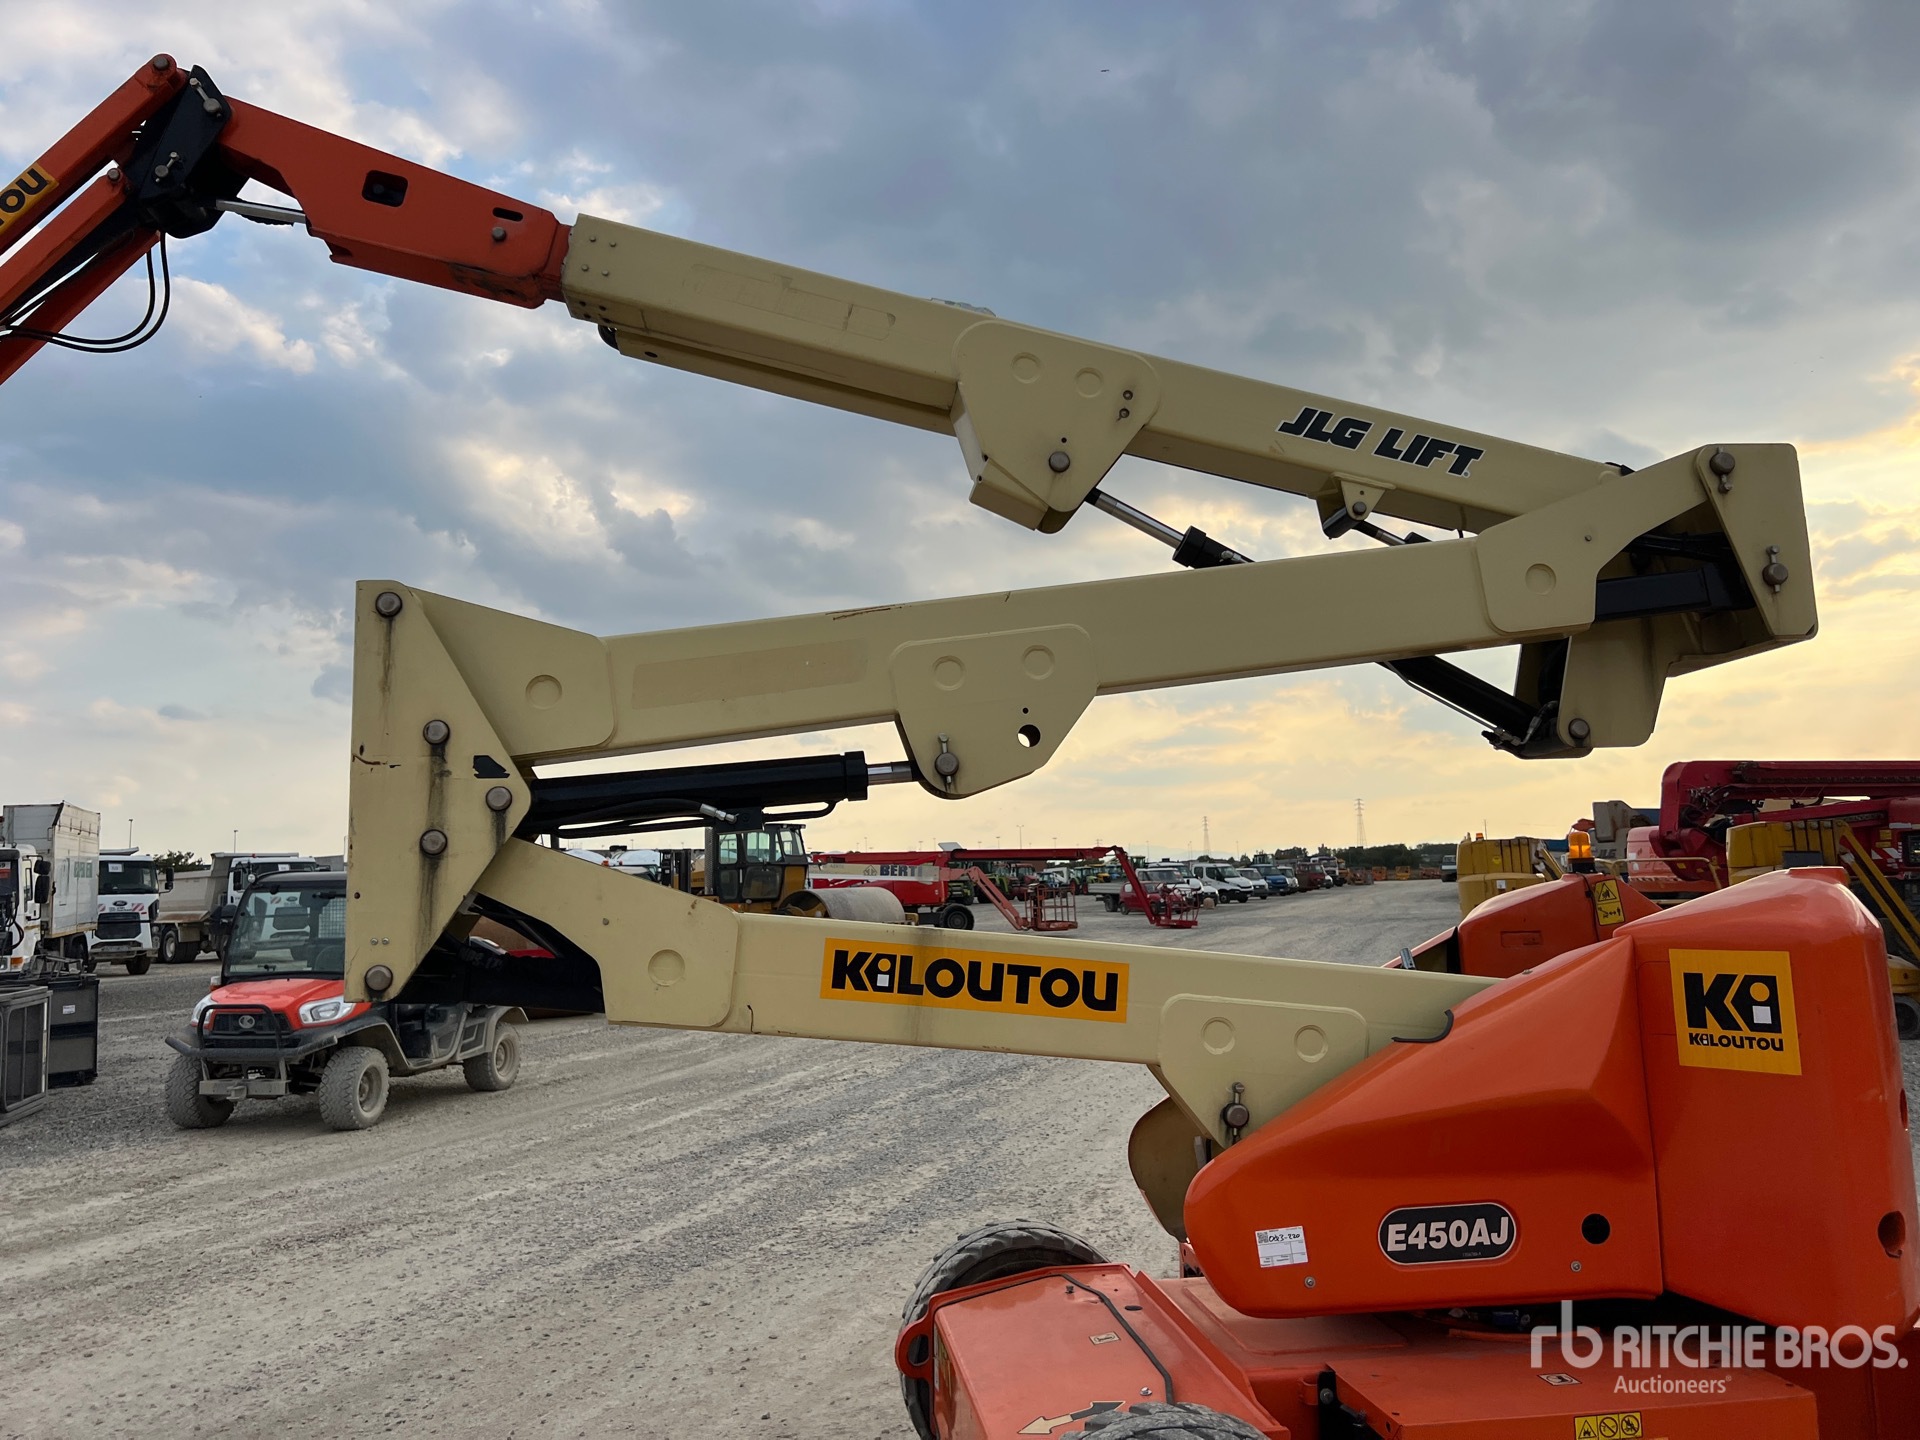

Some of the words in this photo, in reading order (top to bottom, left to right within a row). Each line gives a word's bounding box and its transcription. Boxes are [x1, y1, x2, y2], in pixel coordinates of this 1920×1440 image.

[0, 168, 48, 226] OU
[1277, 406, 1375, 451] JLG
[1372, 427, 1486, 477] LIFT
[1387, 1216, 1509, 1252] E450AJ
